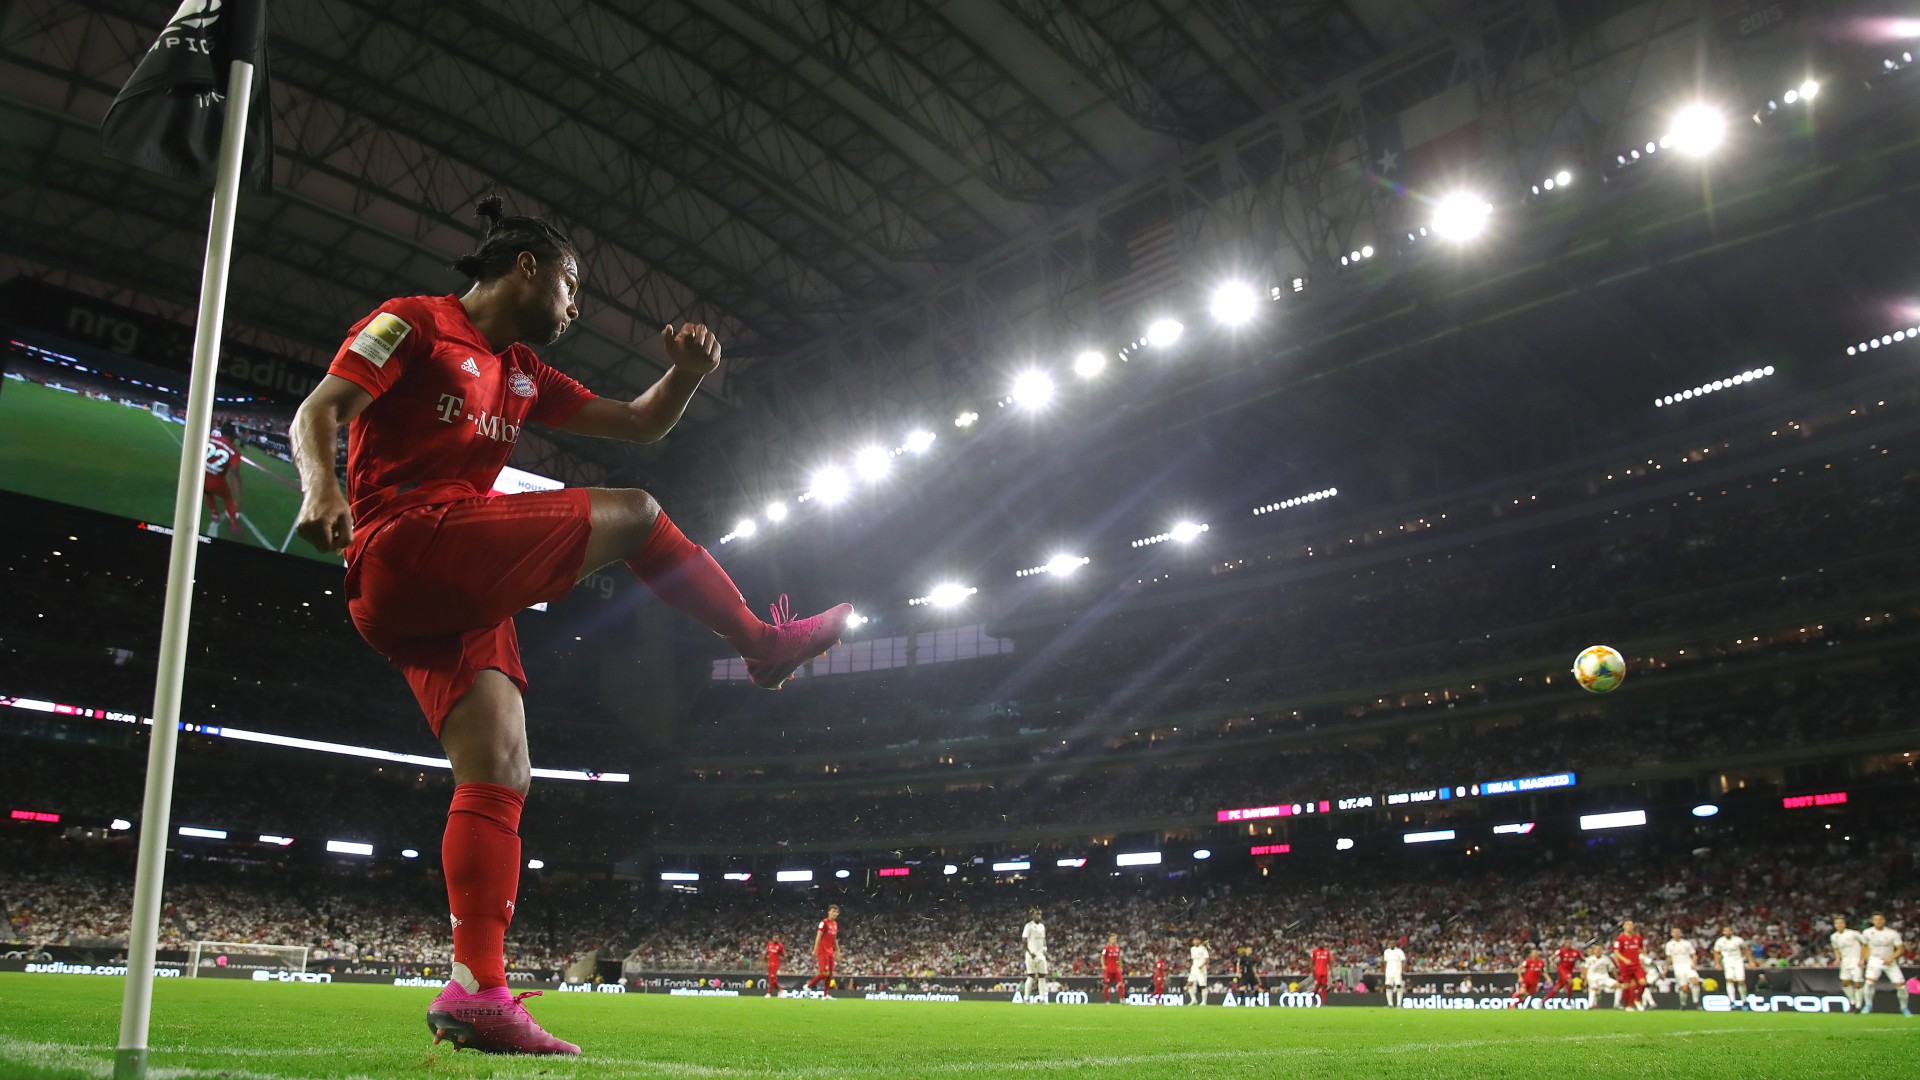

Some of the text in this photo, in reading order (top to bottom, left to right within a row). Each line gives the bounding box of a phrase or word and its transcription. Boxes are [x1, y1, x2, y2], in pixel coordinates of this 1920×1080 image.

[67, 306, 316, 396] nrg tadiu
[1228, 809, 1241, 820] FC
[1242, 806, 1280, 819] BAYERN
[1410, 790, 1437, 802] HALF
[1487, 781, 1517, 794] REAL
[1519, 774, 1570, 790] MADRID
[252, 970, 332, 984] e-tron
[558, 981, 592, 993] Audi
[865, 991, 960, 1003] audiusa.com/etron
[1126, 993, 1185, 1007] OUSTON
[1702, 993, 1850, 1013] e-tron
